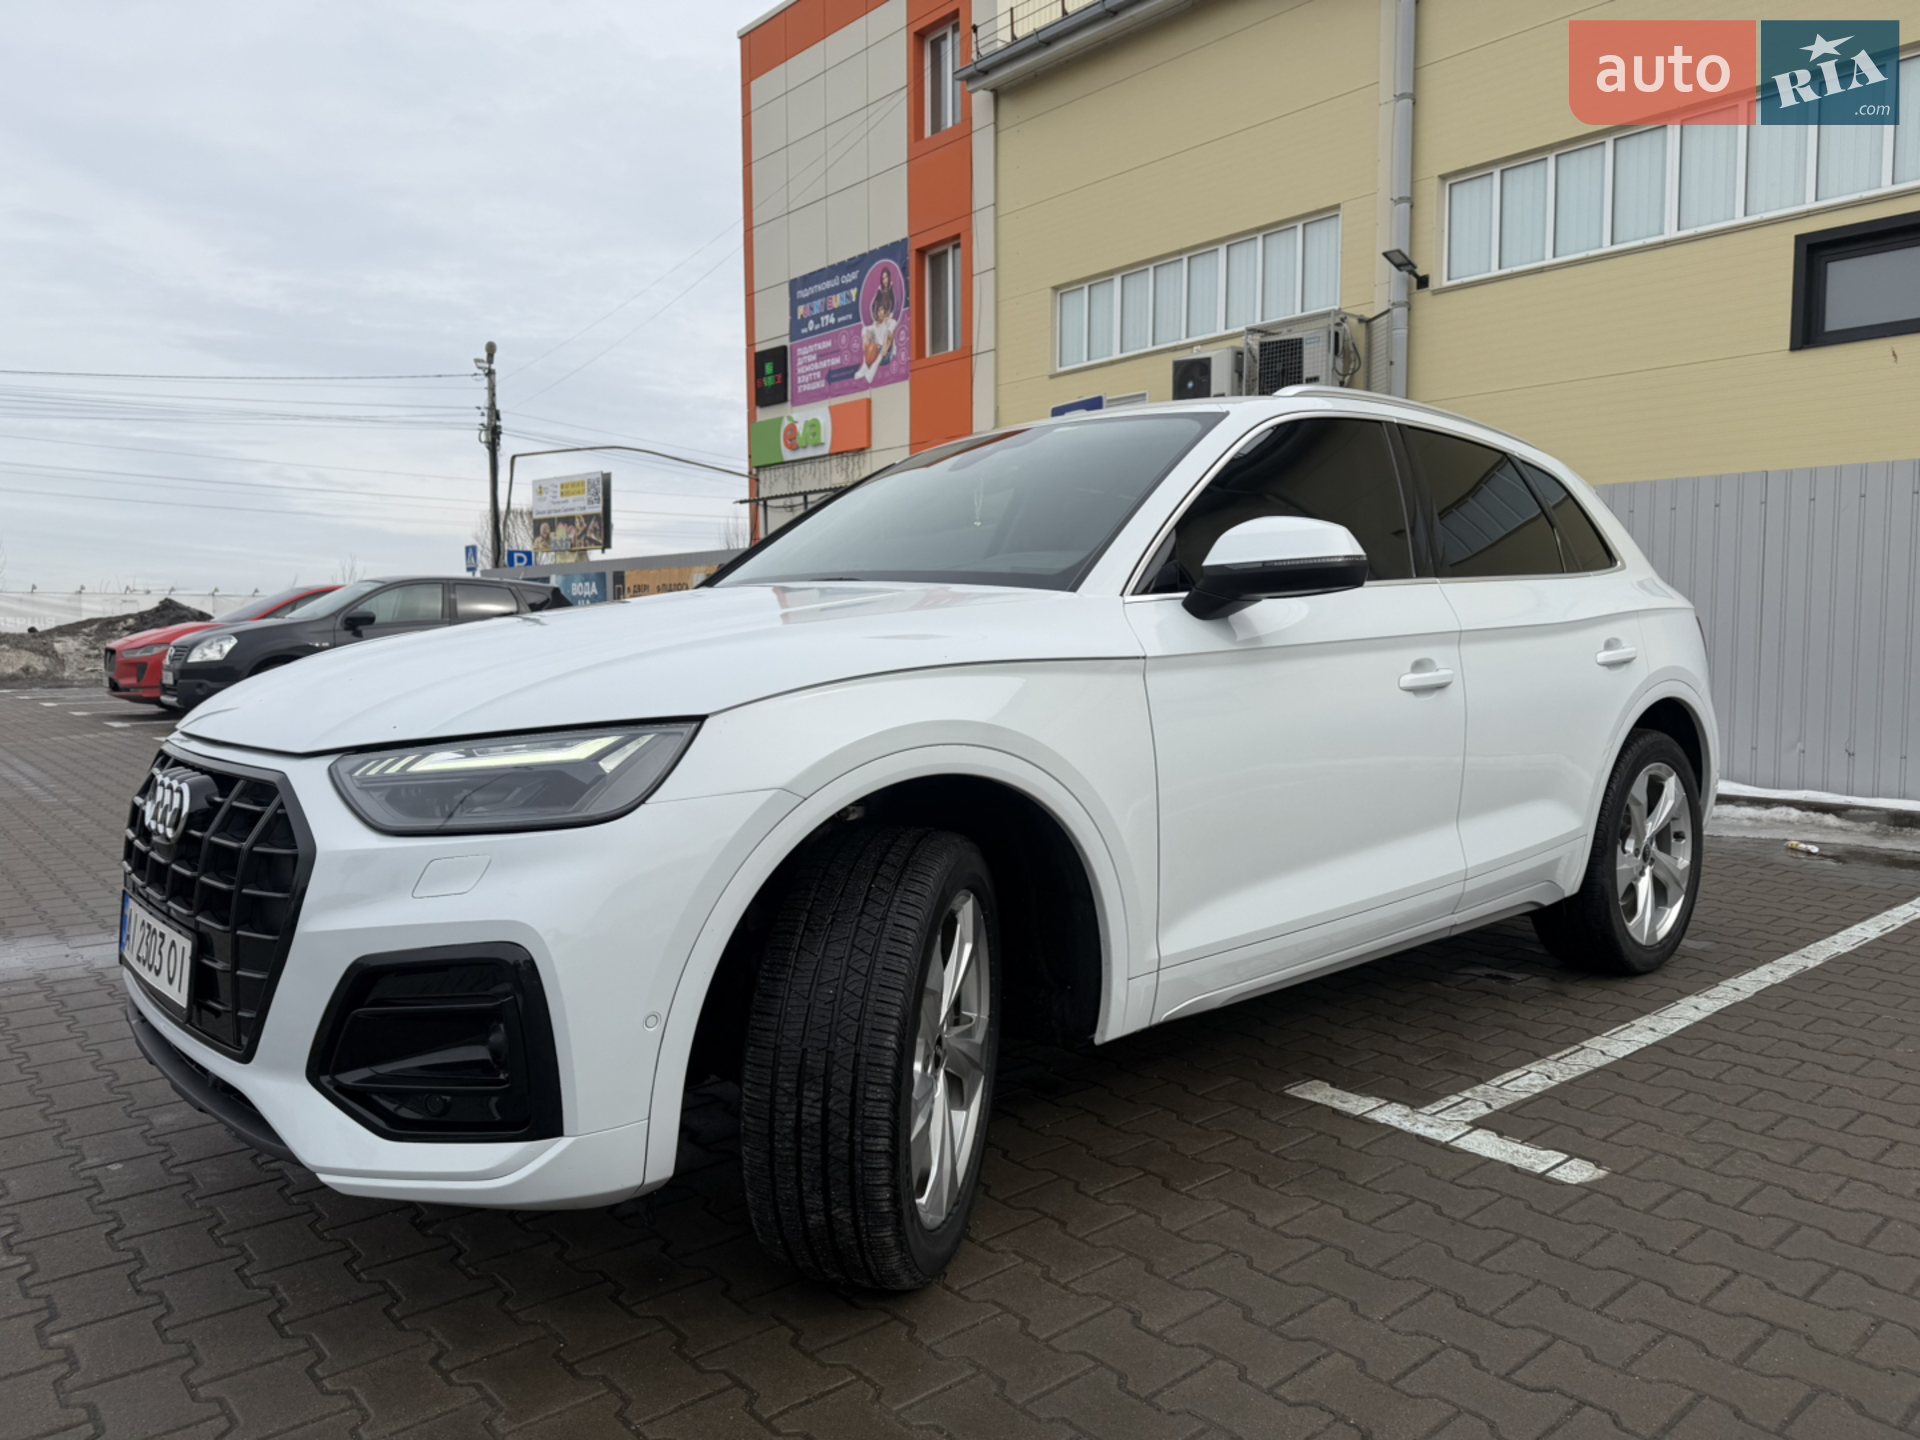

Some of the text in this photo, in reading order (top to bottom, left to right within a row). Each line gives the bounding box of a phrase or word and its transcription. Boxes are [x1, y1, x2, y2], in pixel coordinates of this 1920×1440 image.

[827, 287, 858, 310] BUNNY
[808, 319, 814, 331] 0
[820, 312, 836, 328] 174
[513, 552, 528, 568] P
[571, 581, 598, 598] ВОДА
[136, 918, 166, 977] 2303
